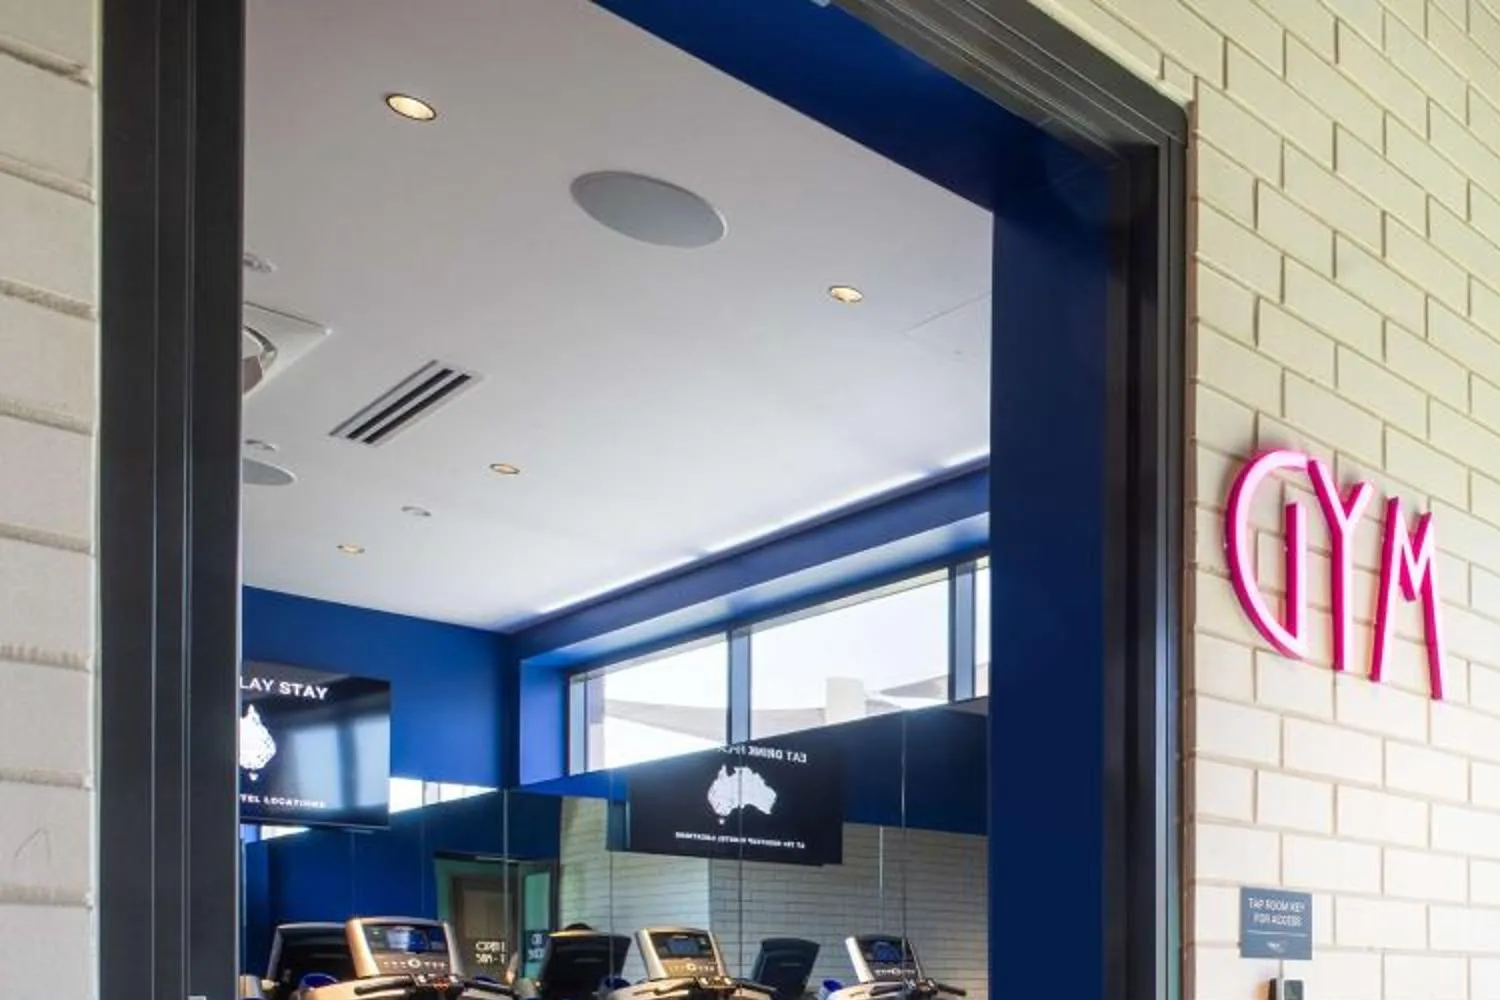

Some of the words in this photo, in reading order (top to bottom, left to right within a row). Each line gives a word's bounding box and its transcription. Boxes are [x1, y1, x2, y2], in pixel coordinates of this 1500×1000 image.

[1225, 448, 1446, 701] GYM
[240, 677, 274, 692] LAY
[279, 681, 328, 701] STAY
